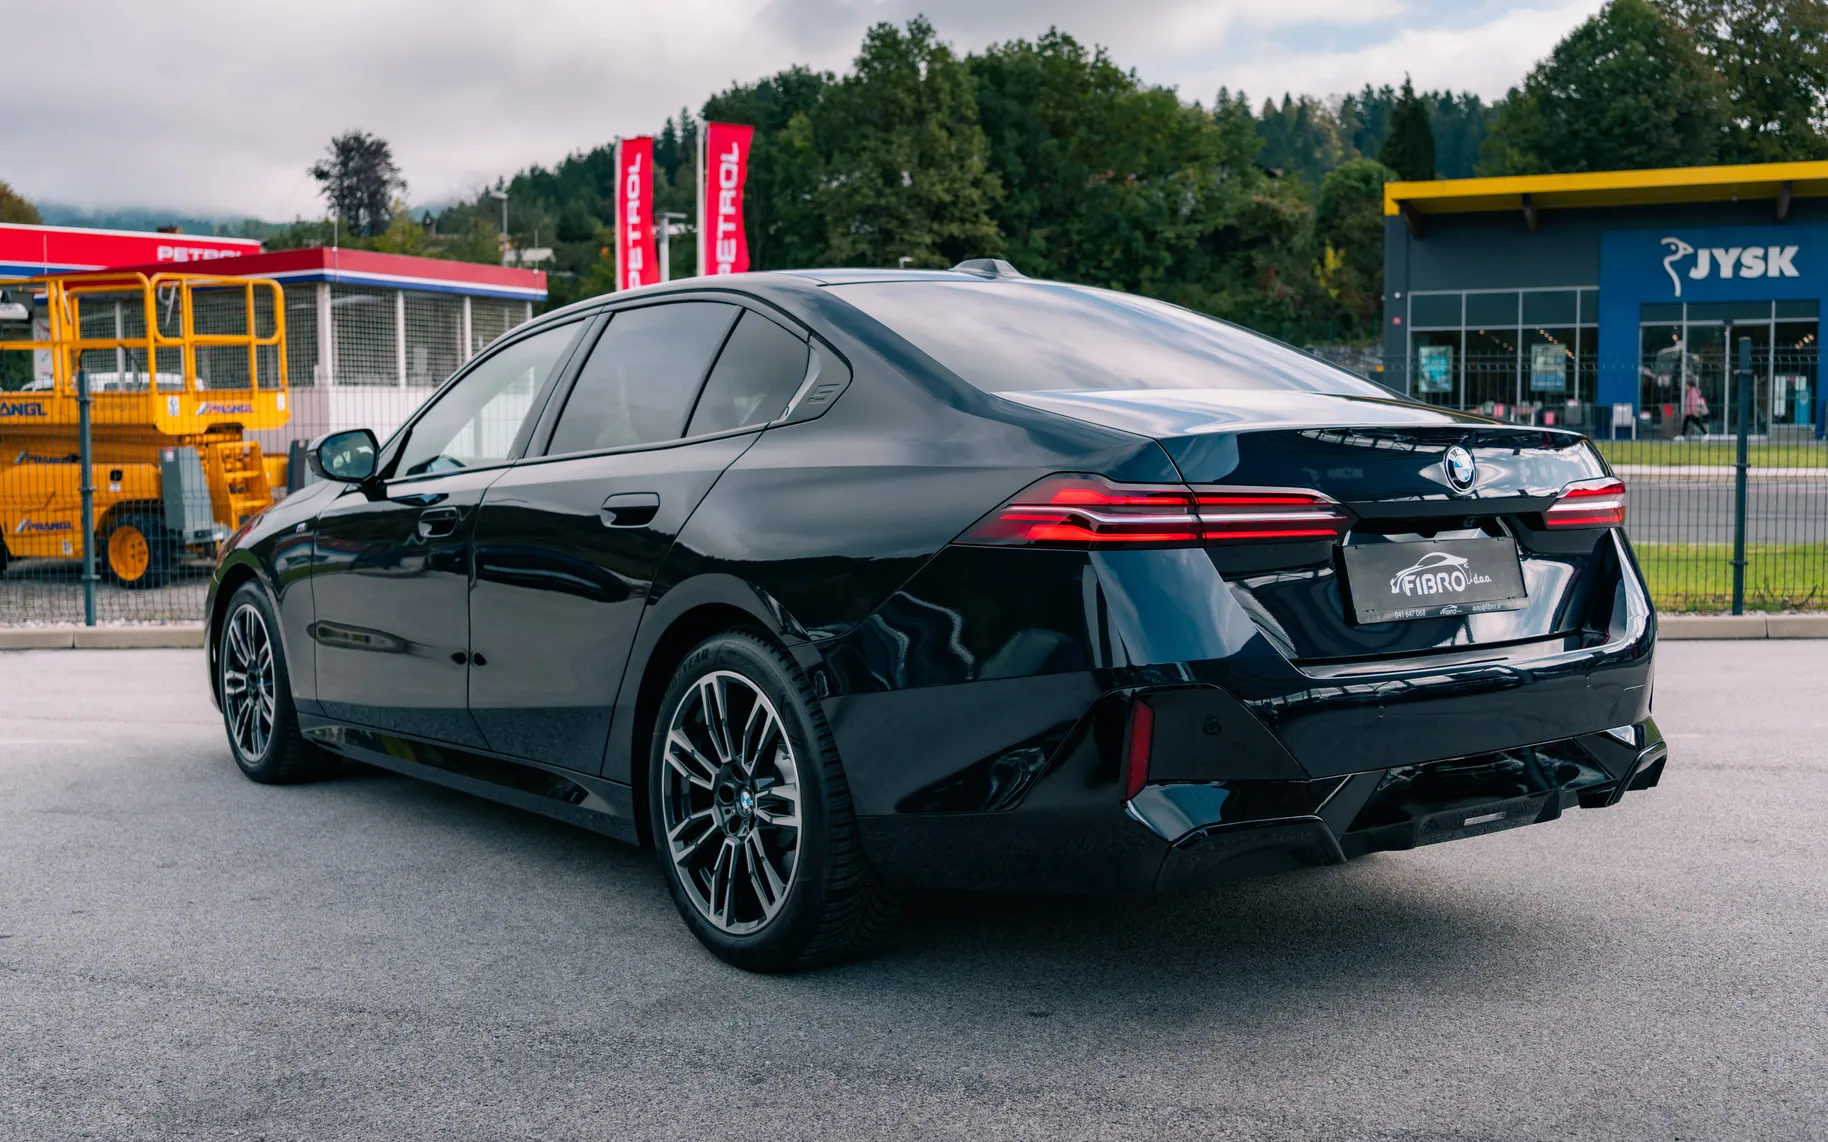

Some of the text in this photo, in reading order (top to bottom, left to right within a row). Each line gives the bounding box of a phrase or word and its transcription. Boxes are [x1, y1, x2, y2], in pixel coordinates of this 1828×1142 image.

[1689, 245, 1800, 280] JYSK
[1402, 571, 1492, 597] FIBRO d.o.o.
[1394, 608, 1426, 619] 041 647 068
